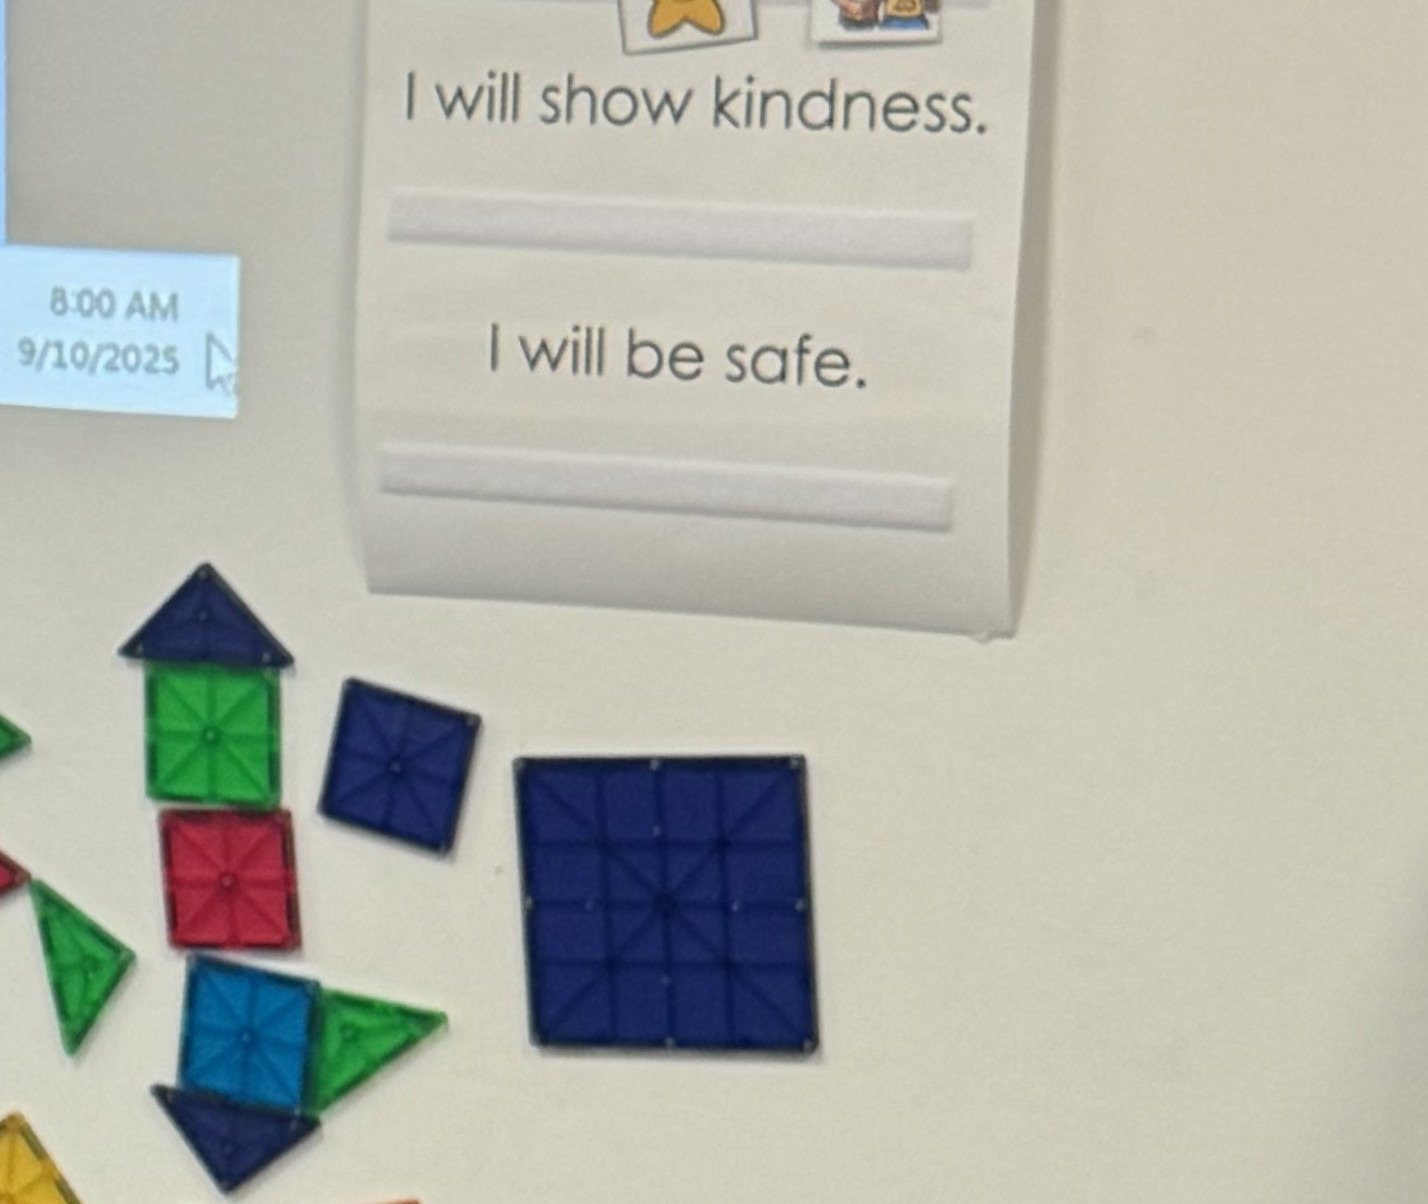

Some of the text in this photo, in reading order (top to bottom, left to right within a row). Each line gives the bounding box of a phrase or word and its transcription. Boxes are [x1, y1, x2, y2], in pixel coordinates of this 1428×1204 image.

[406, 70, 988, 134] I will show kindness.
[49, 286, 179, 321] 8:00 AM
[18, 338, 180, 375] 9/10/2025
[490, 323, 867, 389] I will be safe.
